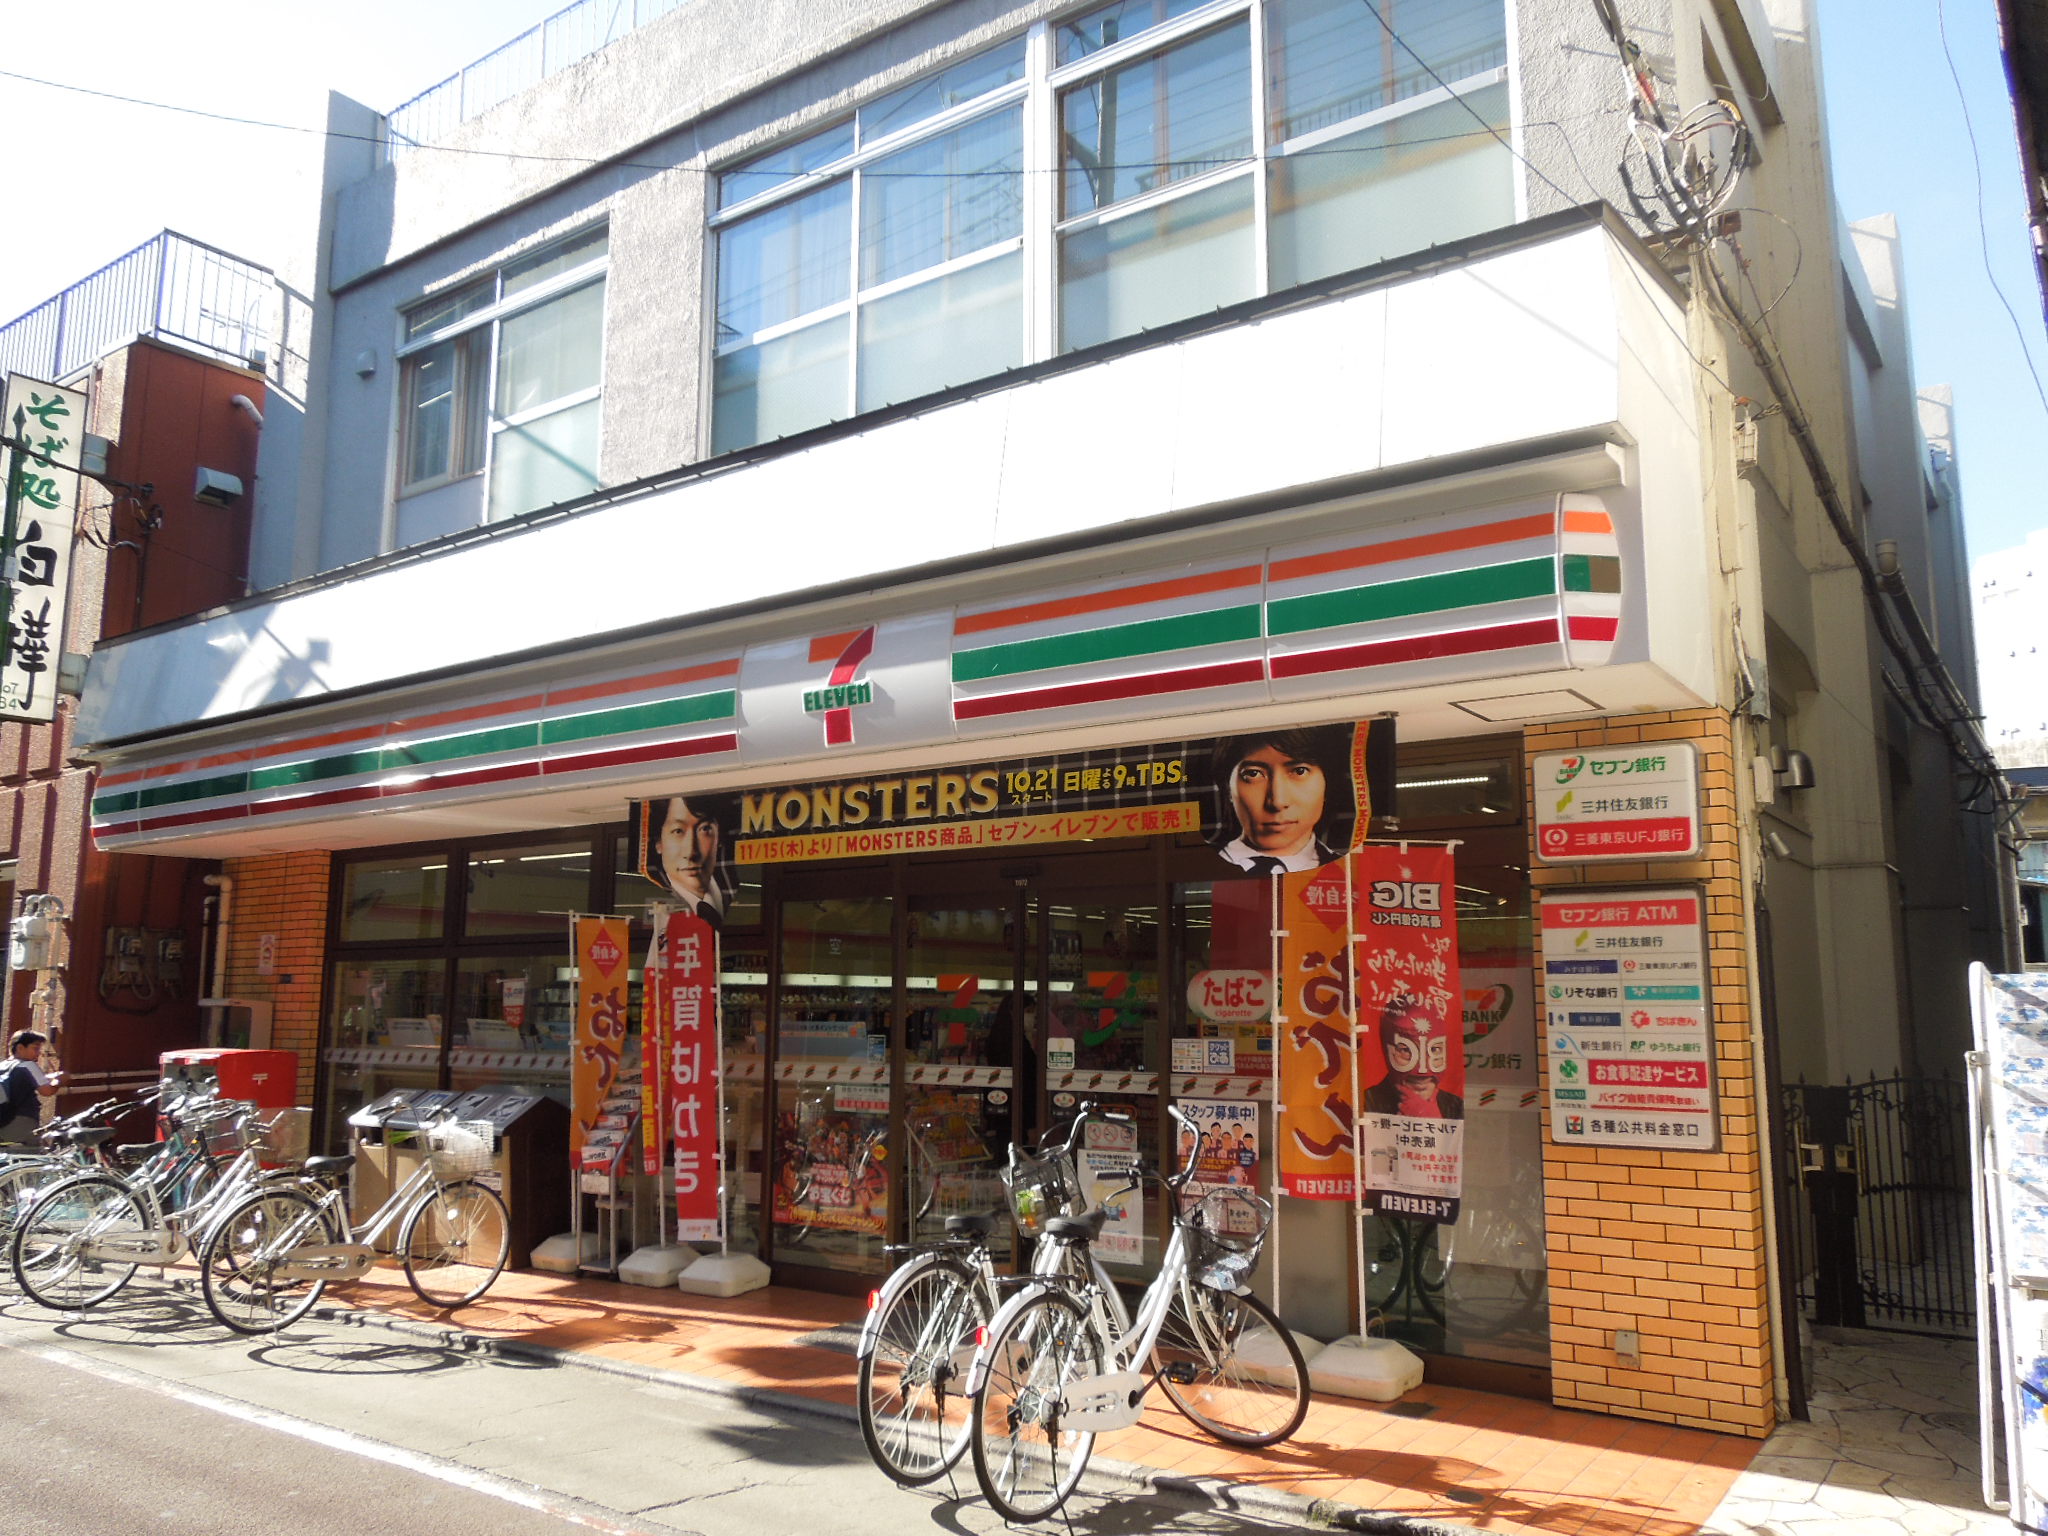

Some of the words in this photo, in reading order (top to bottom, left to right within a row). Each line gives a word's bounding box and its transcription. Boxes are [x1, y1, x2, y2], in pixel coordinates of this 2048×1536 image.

[22, 391, 71, 510] そば処
[1590, 756, 1667, 776] セブン銀行
[1353, 748, 1368, 809] MONSTERS
[740, 769, 1000, 837] MONSTERS
[1004, 768, 1058, 794] 10.21
[1011, 792, 1053, 805] スタート
[1581, 795, 1669, 814] 三井住友銀行
[1574, 828, 1685, 846] 三菱東京UFJ銀行
[1559, 907, 1631, 923] セブン銀行
[1636, 906, 1678, 921] ATM
[1595, 936, 1663, 948] 三井住友銀行
[1203, 976, 1265, 1007] たばこ
[1565, 987, 1618, 998] りそな銀行
[1581, 1040, 1622, 1051] 新生銀行
[1649, 1042, 1702, 1053] ゆうちょ銀行
[1463, 1054, 1522, 1069] ブン銀行
[1596, 1064, 1699, 1082] お食事配達サービス
[1182, 1104, 1255, 1121] スタッフ募集中!
[1590, 1119, 1699, 1137] 各種公共料金窓口
